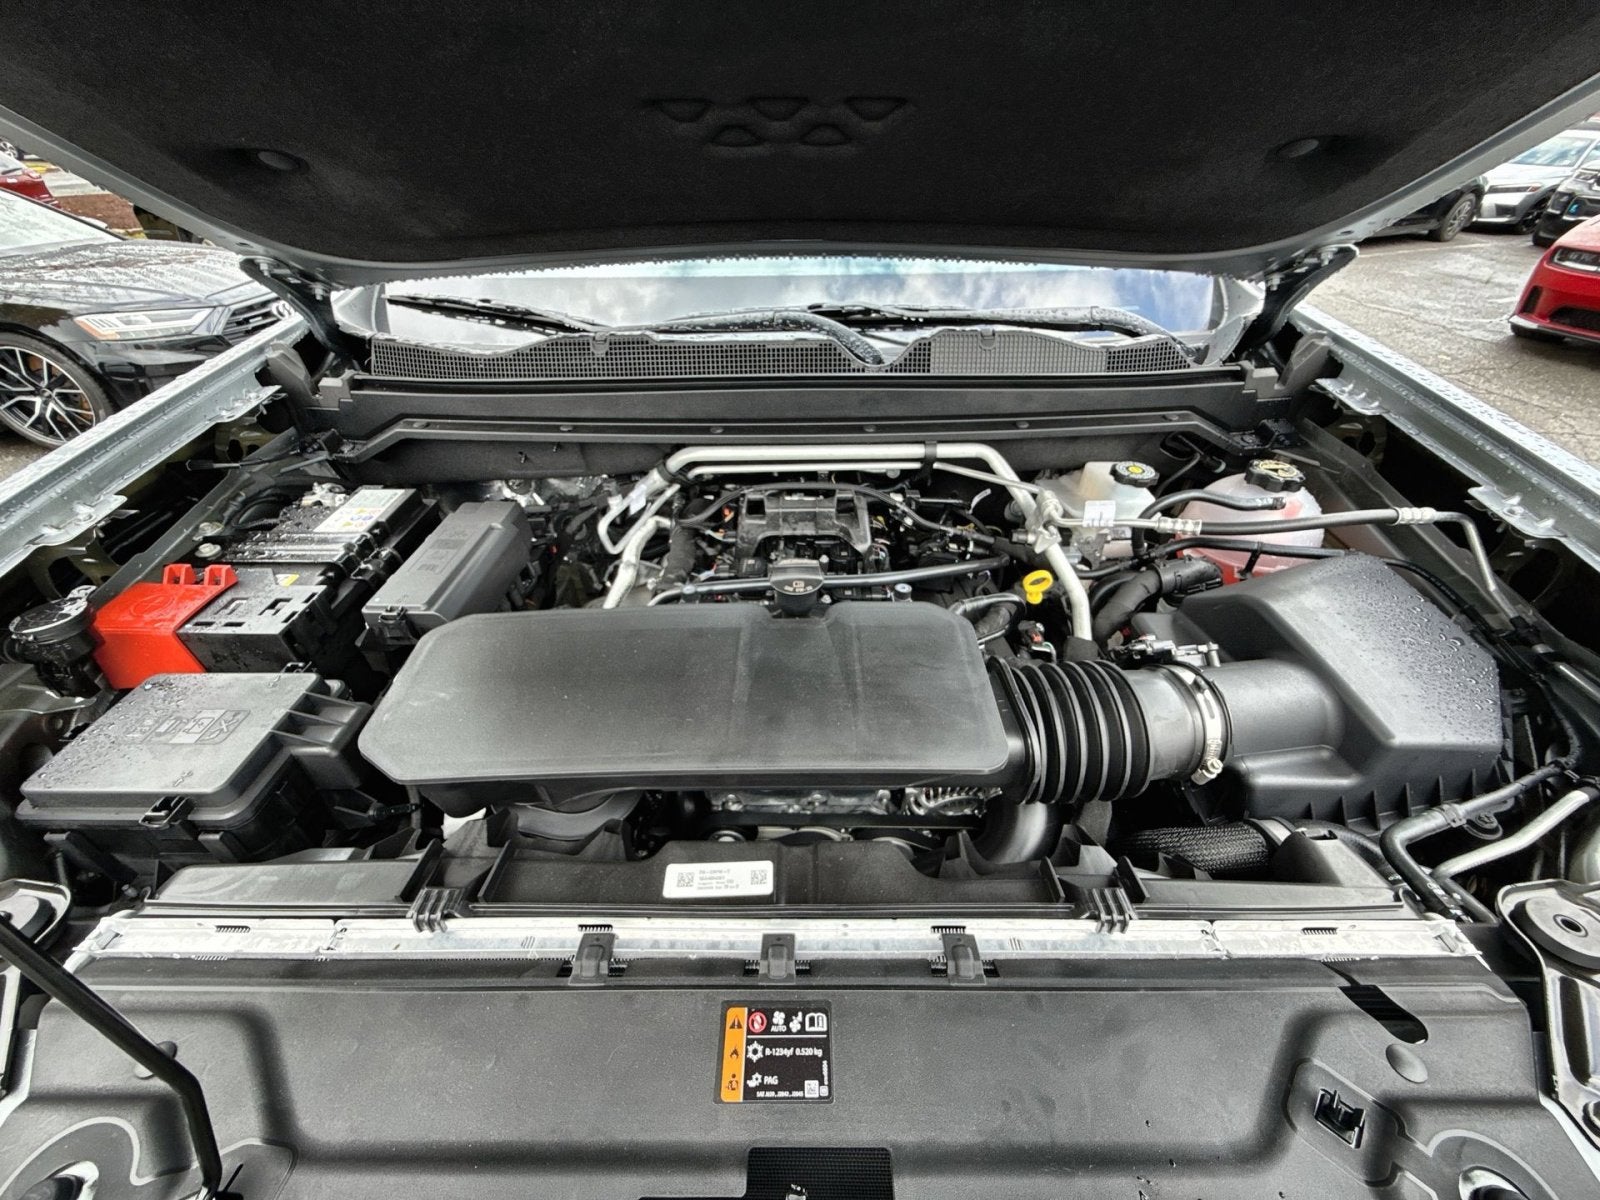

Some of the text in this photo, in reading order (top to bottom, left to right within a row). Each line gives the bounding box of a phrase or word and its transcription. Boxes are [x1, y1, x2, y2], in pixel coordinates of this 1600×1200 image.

[795, 1047, 814, 1056] 0.520
[814, 1046, 823, 1058] kg
[763, 1075, 779, 1085] PAG
